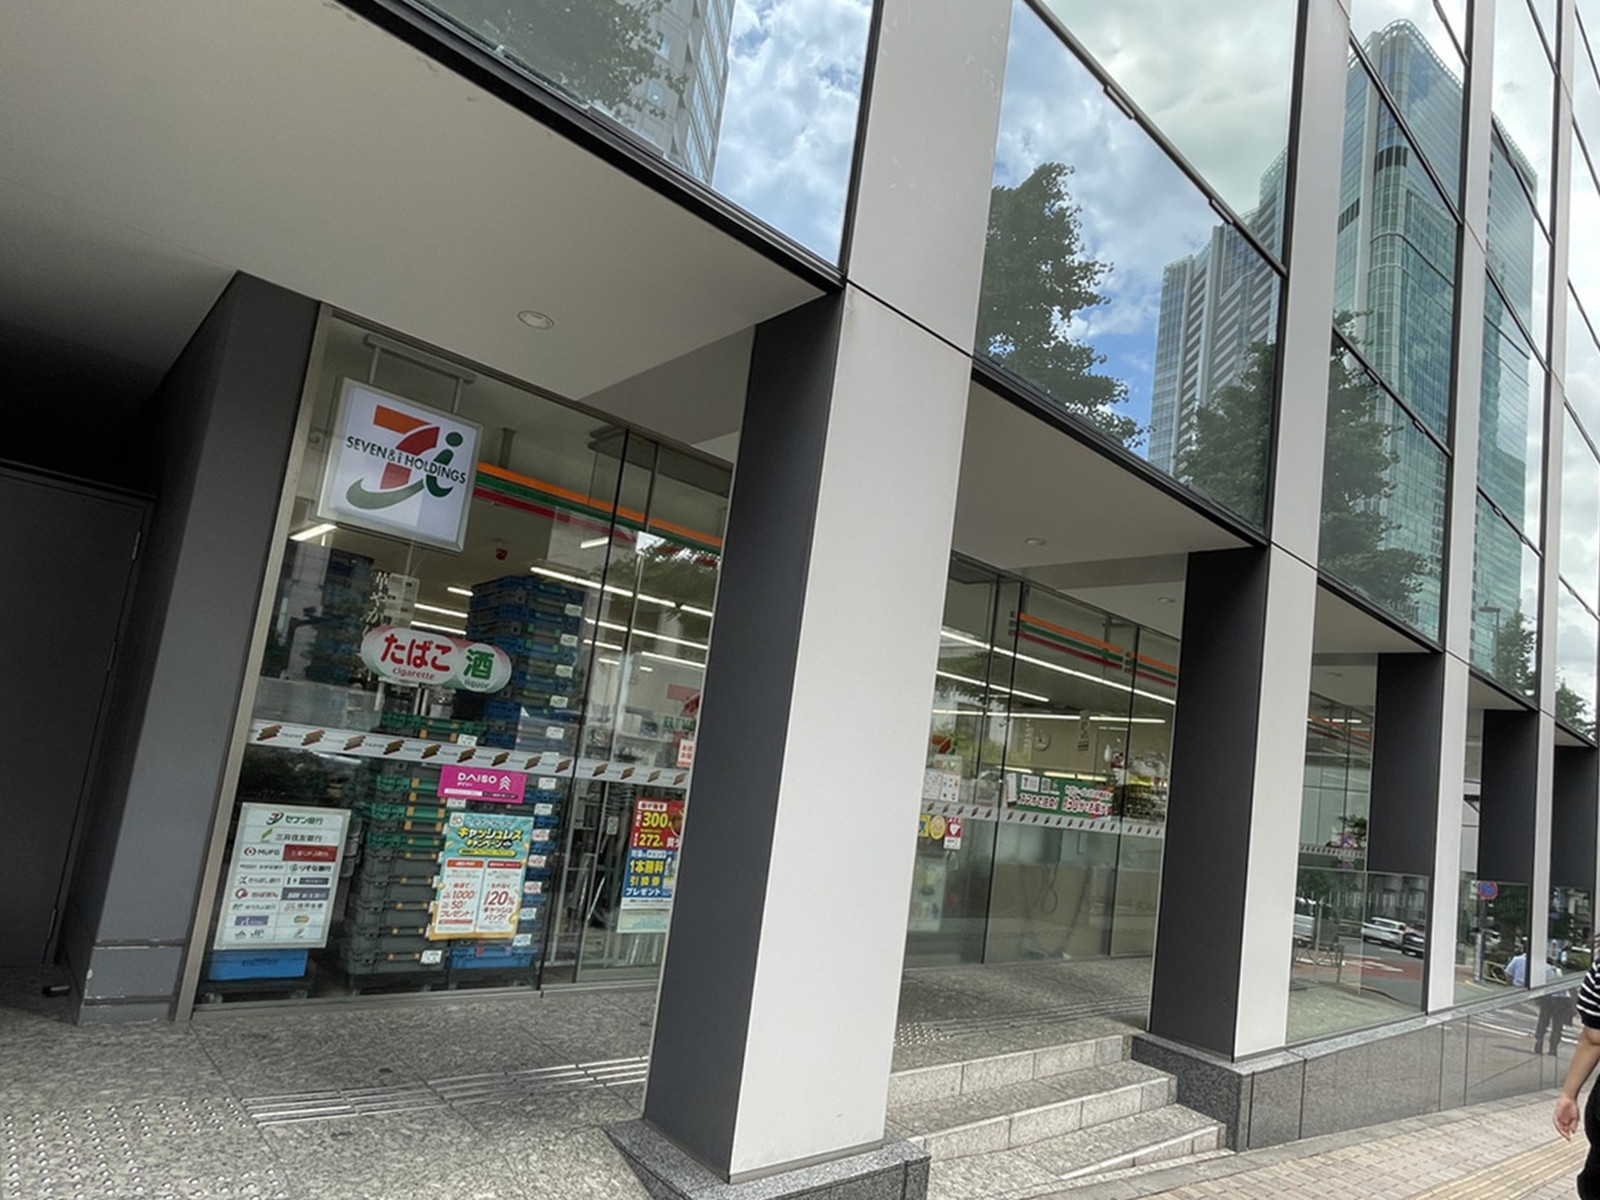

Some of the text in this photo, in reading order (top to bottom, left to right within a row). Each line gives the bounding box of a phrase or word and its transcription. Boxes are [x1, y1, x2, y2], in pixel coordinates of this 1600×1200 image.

[404, 455, 466, 485] HOLDINGS
[380, 633, 453, 672] たばこ
[463, 648, 495, 680] 酒
[392, 666, 436, 680] cigarette
[457, 772, 498, 784] DAISO
[285, 815, 323, 826] セブン銀行
[458, 826, 524, 841] キャッシュレス
[629, 859, 665, 874] 1本無料
[625, 887, 661, 896] プレゼント
